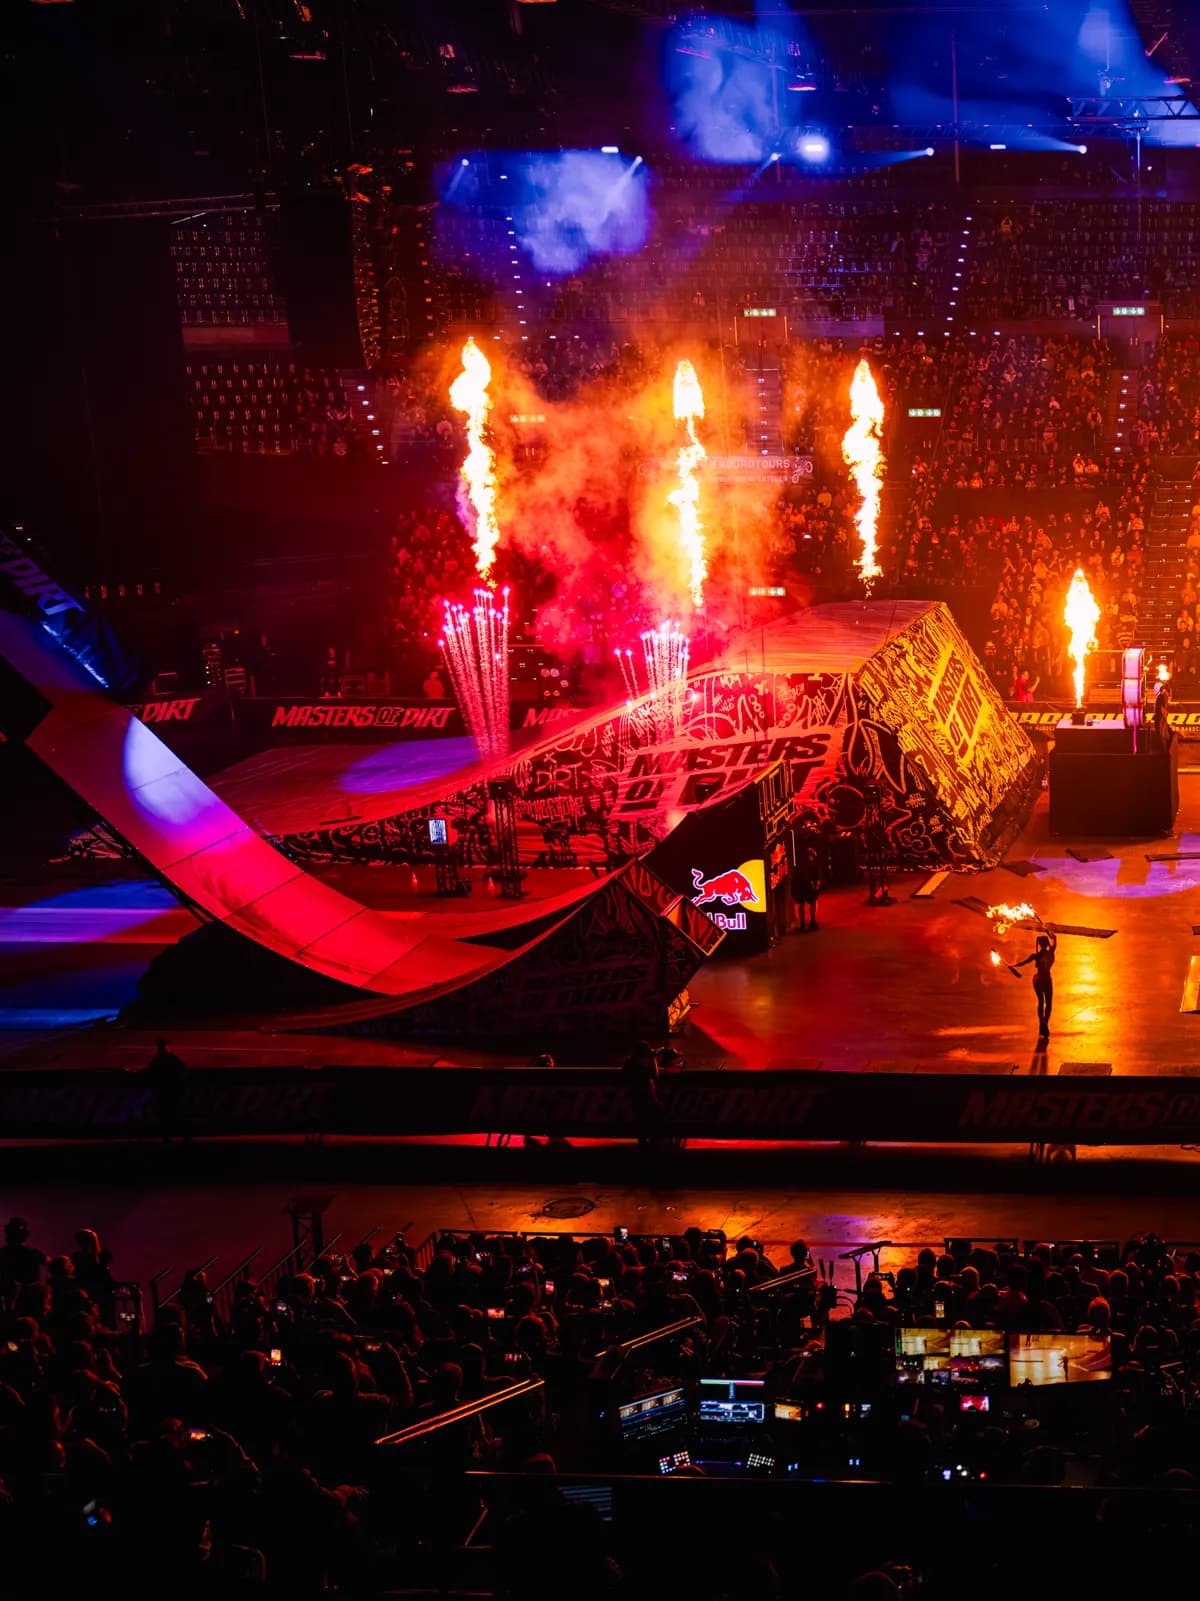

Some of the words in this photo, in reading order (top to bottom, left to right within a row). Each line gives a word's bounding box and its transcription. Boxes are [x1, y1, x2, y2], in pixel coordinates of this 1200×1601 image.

[142, 698, 200, 723] DIRT
[272, 706, 377, 728] MASTERS
[374, 706, 402, 727] OF
[399, 707, 456, 728] DIRT
